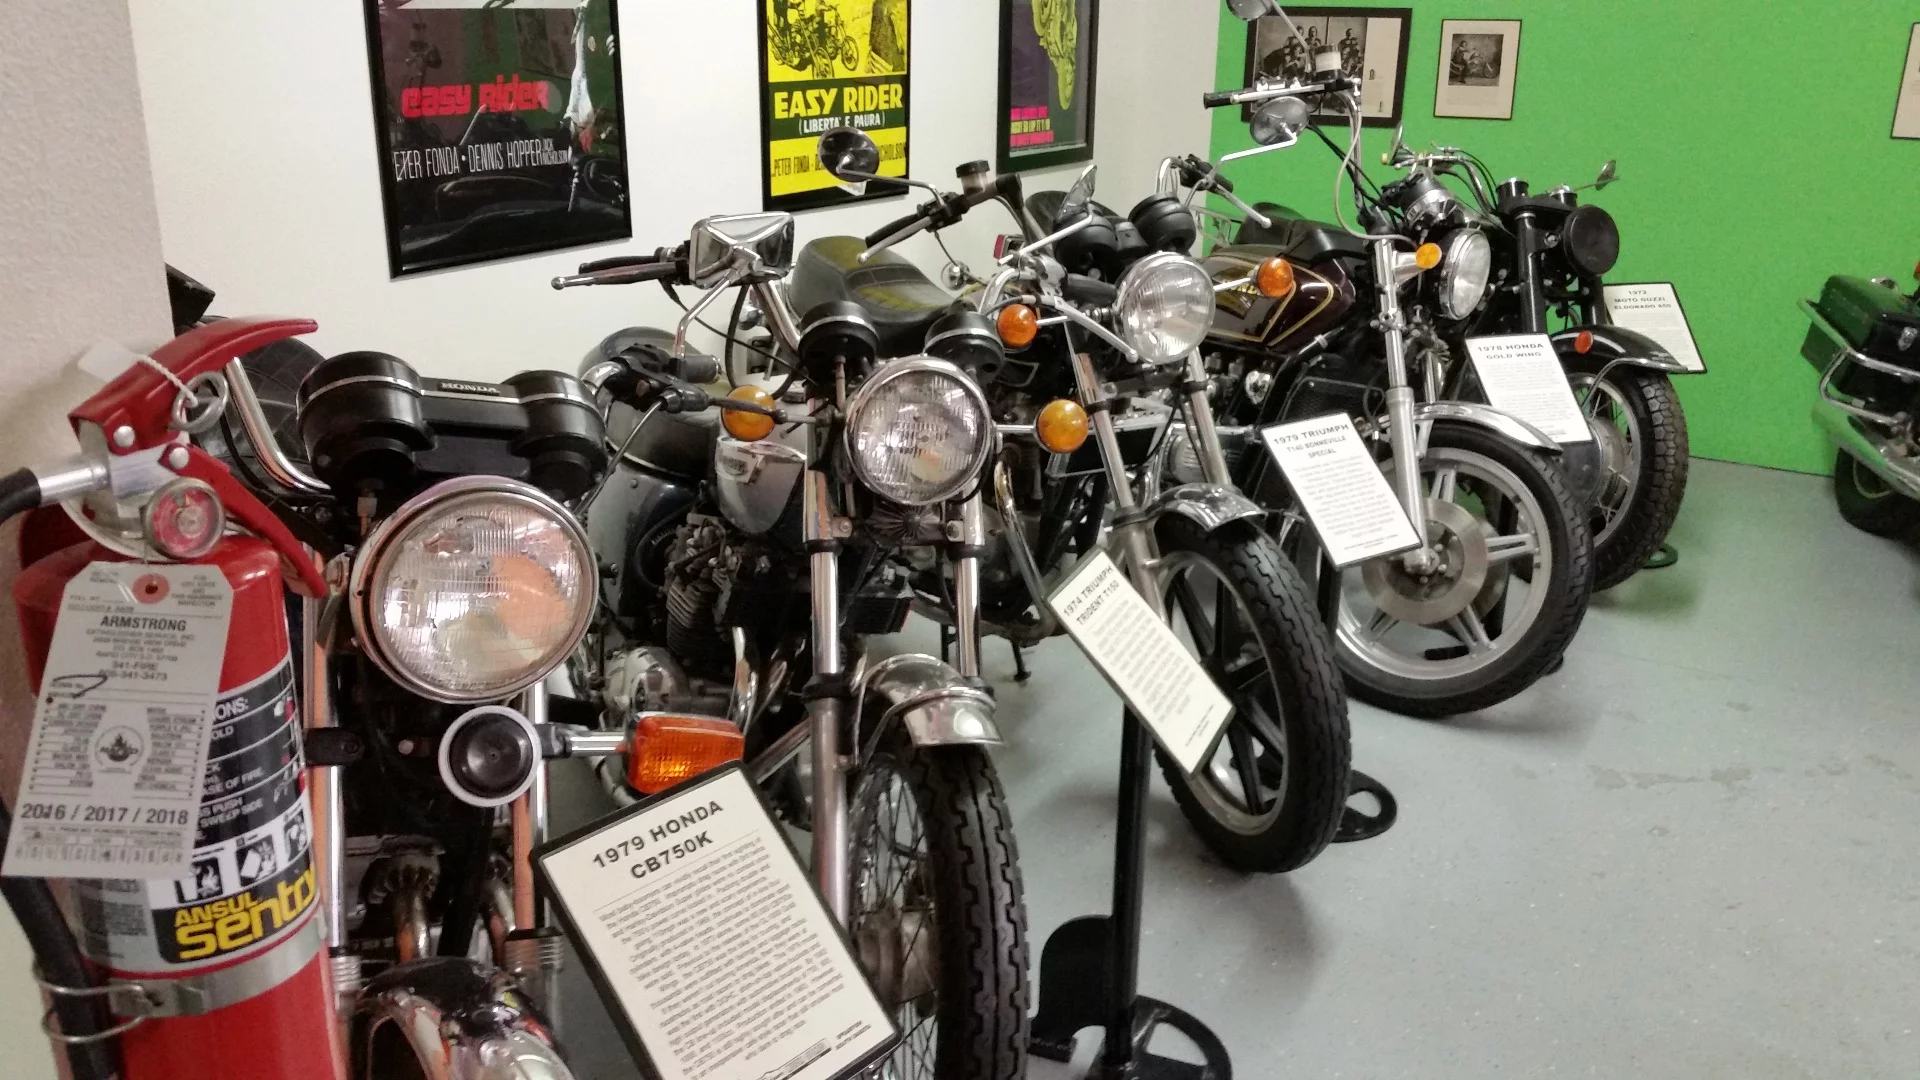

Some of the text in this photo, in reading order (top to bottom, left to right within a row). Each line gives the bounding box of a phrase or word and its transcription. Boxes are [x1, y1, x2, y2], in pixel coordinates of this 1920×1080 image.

[402, 84, 471, 117] easy
[774, 84, 903, 119] EASY RIDER
[855, 112, 885, 128] PAURA)
[394, 139, 543, 181] ETER FONDA DENNIS HOPPER
[440, 382, 500, 395] HONDA
[1273, 424, 1349, 445] 1979 TRIUMPH
[1308, 448, 1336, 458] SPECIAL
[1064, 565, 1113, 616] 1974 TRIUMPH
[100, 615, 187, 632] ARMSTRONG
[1076, 594, 1104, 625] TRIDENT
[20, 803, 67, 820] 2016
[84, 805, 128, 822] 2017
[145, 808, 189, 825] 2018
[592, 799, 724, 871] 1979 HONDA
[630, 830, 713, 880] CB750K
[175, 892, 258, 927] ANSUL
